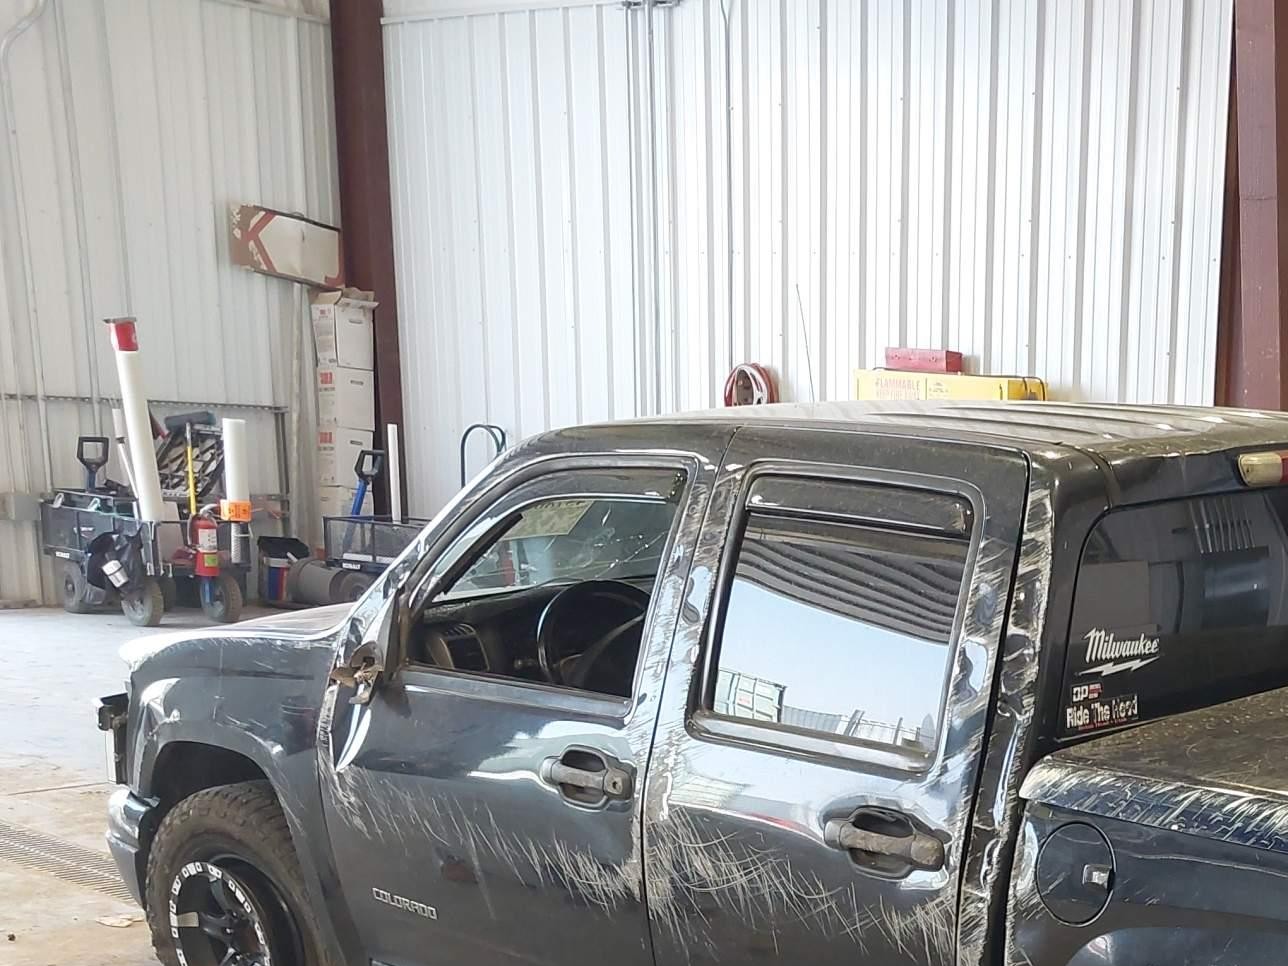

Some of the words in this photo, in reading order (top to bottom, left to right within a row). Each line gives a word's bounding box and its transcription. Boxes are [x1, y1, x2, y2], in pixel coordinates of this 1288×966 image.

[1084, 627, 1160, 663] Milwaukee
[1066, 705, 1090, 729] Ride
[1091, 702, 1110, 723] The
[372, 887, 437, 920] COLORADO
